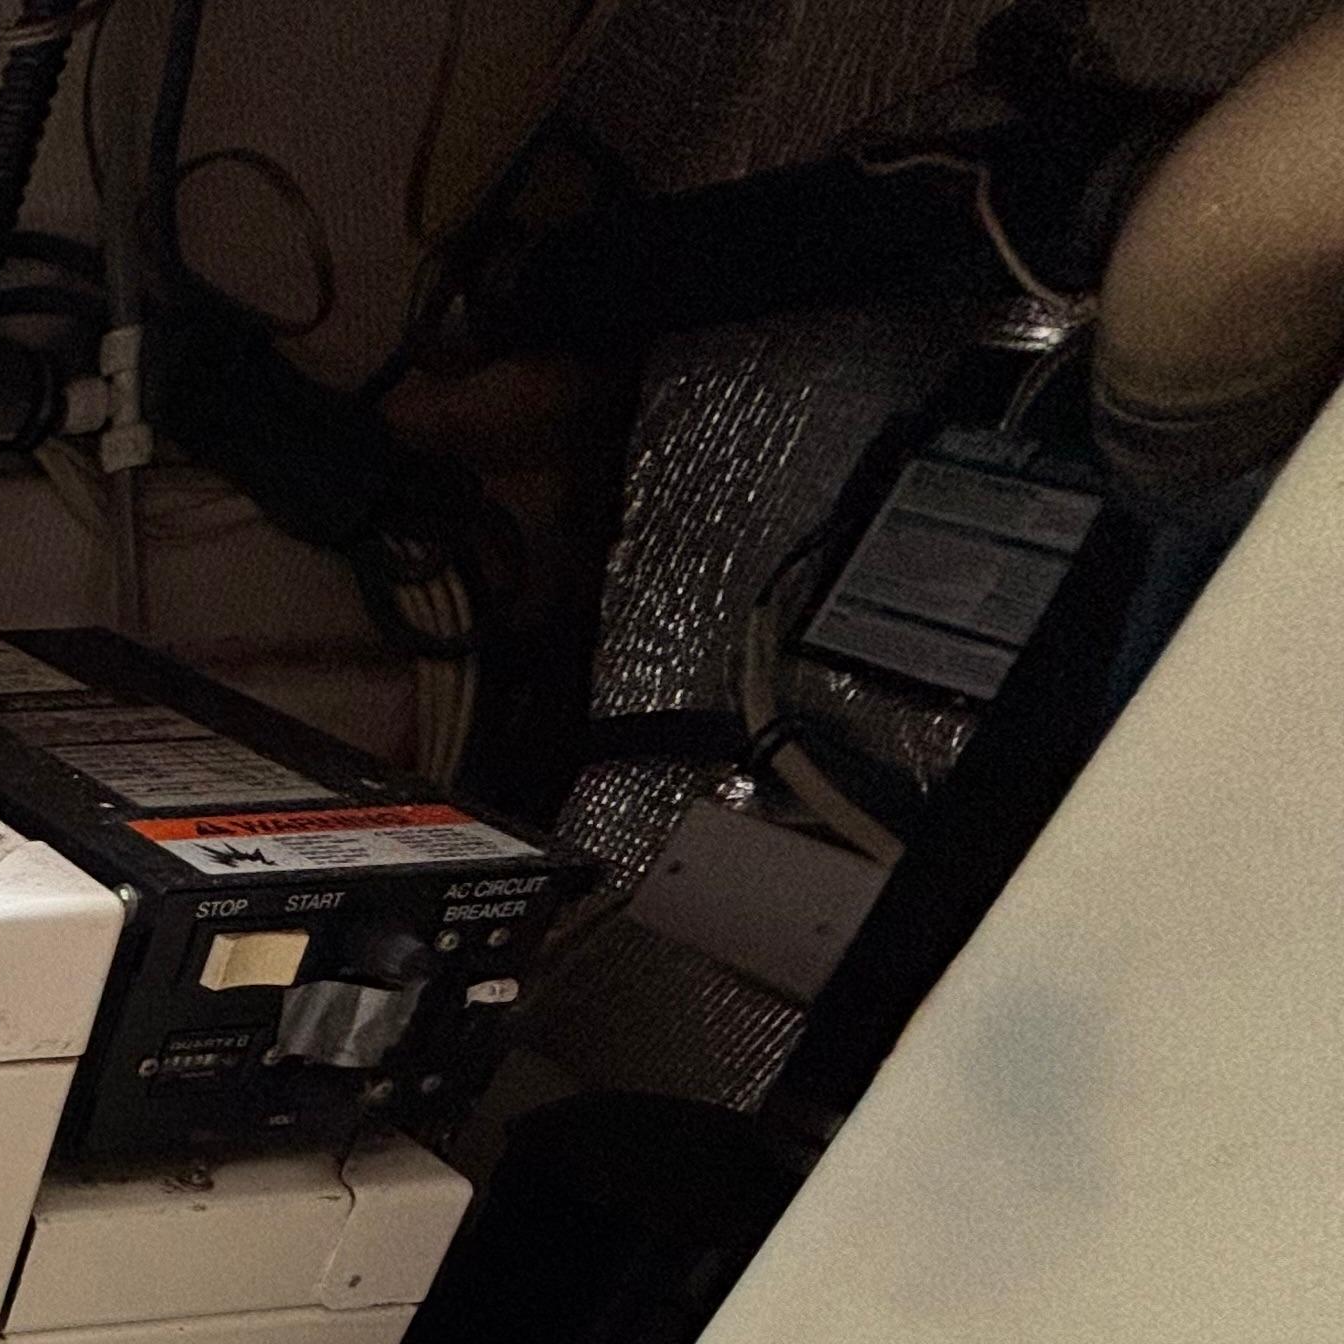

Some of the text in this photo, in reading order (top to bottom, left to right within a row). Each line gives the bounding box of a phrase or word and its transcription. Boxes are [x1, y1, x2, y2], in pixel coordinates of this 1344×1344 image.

[443, 876, 548, 900] AC CIRCUIT
[196, 899, 248, 920] STOP
[285, 892, 346, 913] START
[443, 900, 527, 922] BREAKER
